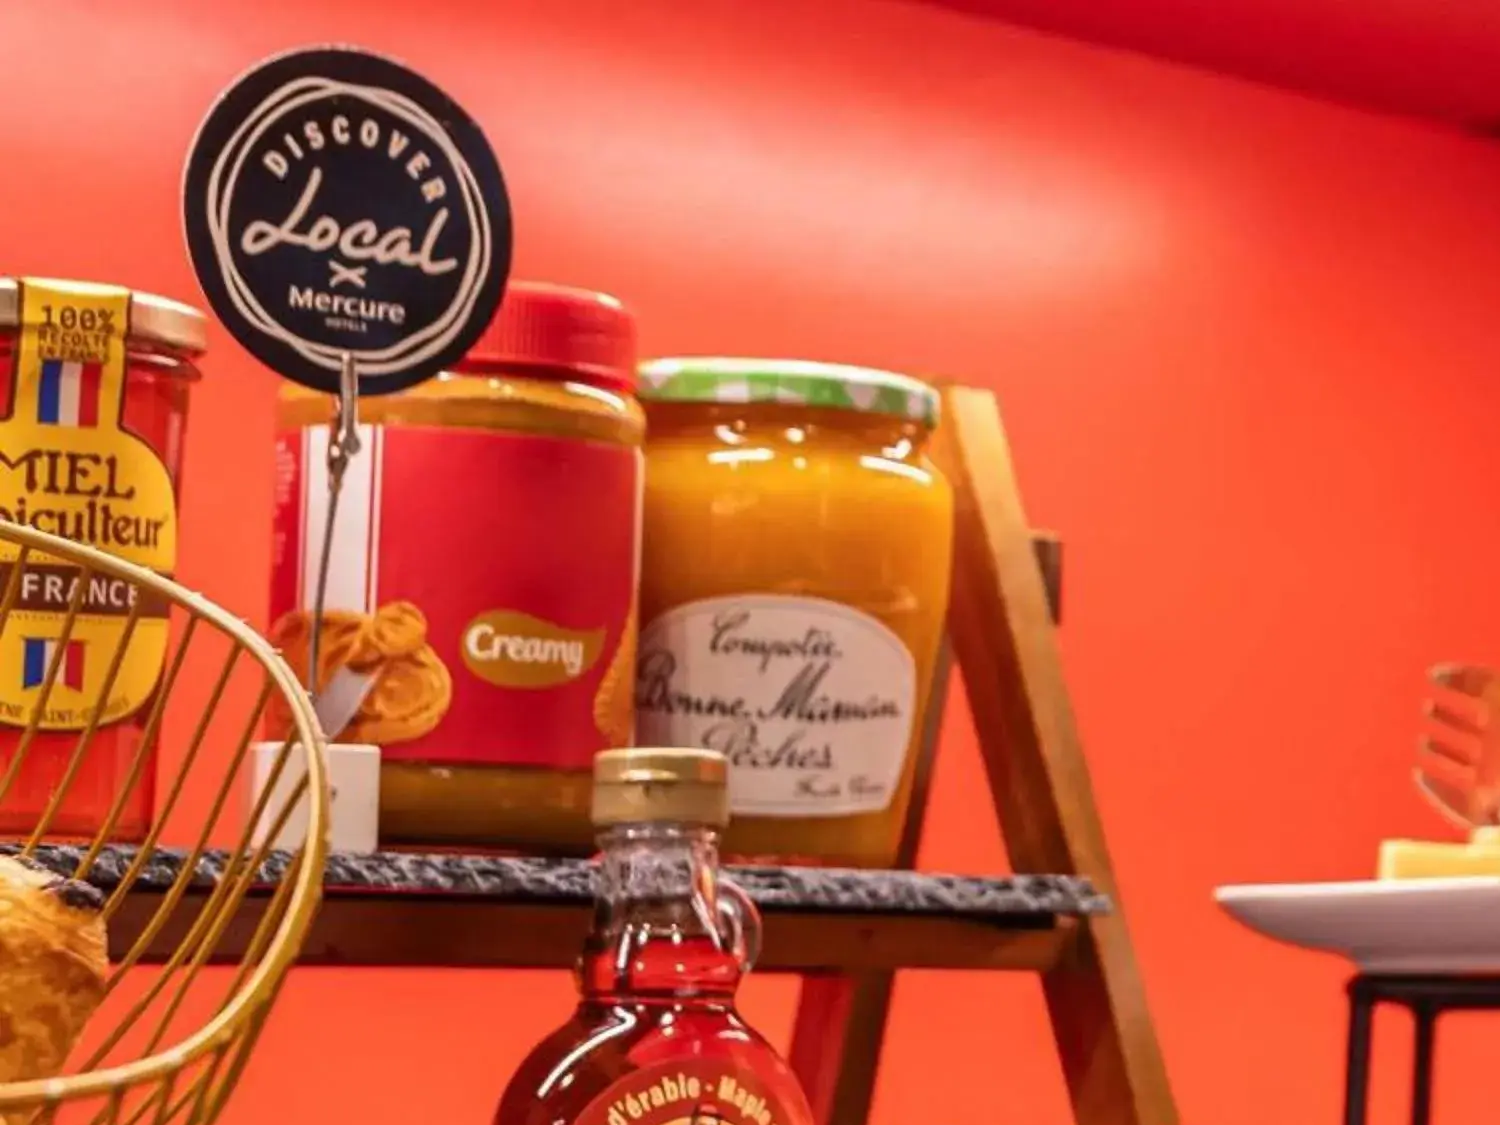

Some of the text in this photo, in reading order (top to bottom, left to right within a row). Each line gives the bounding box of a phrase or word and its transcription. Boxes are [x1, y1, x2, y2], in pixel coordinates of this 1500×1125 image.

[262, 115, 447, 202] DISCOVER
[242, 167, 458, 275] Local
[41, 304, 114, 334] 100%
[288, 285, 406, 324] Mercure
[465, 624, 584, 677] Creamy
